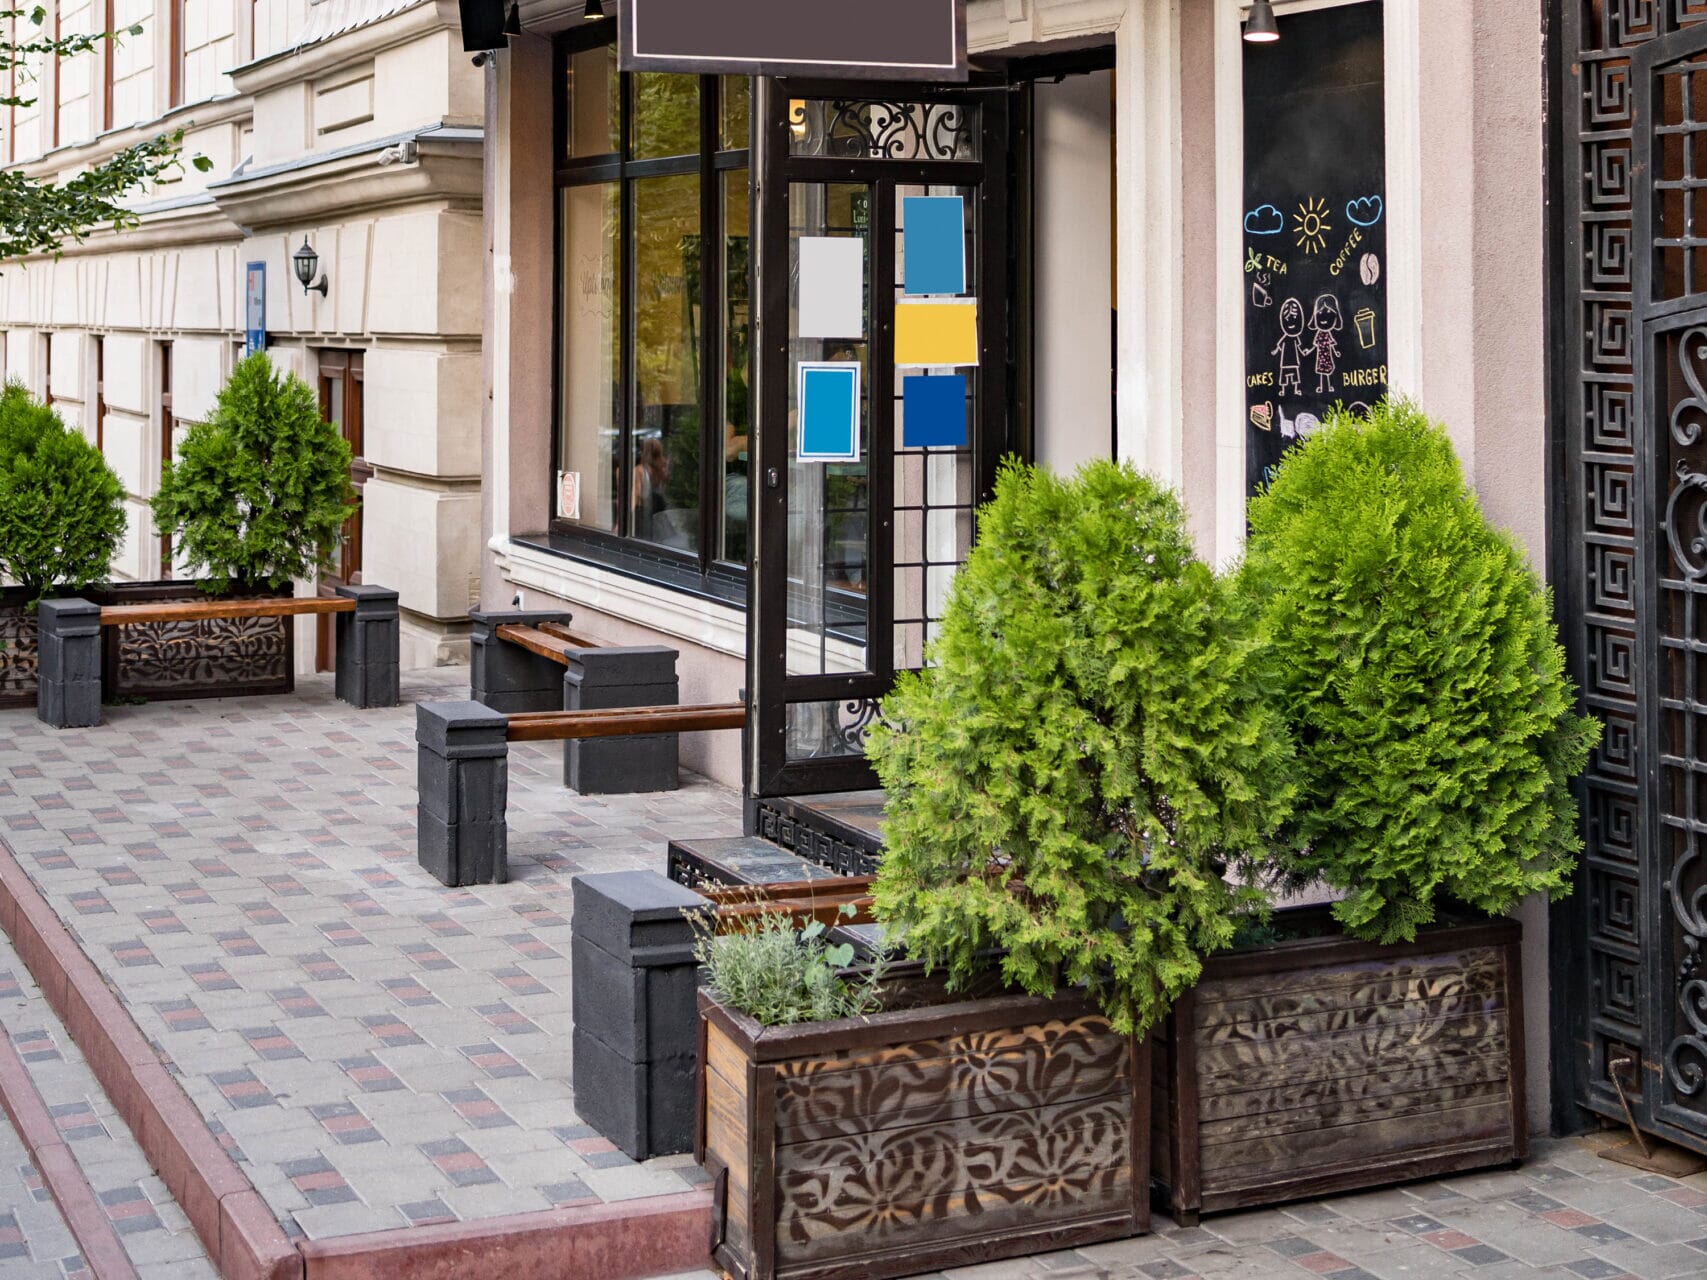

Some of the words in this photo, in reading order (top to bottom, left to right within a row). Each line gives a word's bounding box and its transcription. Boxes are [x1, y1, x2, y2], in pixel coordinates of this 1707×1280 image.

[1330, 227, 1363, 276] COFFEE
[1266, 255, 1288, 275] TEA
[1247, 372, 1274, 387] CAKES
[1343, 365, 1388, 387] BURGER
